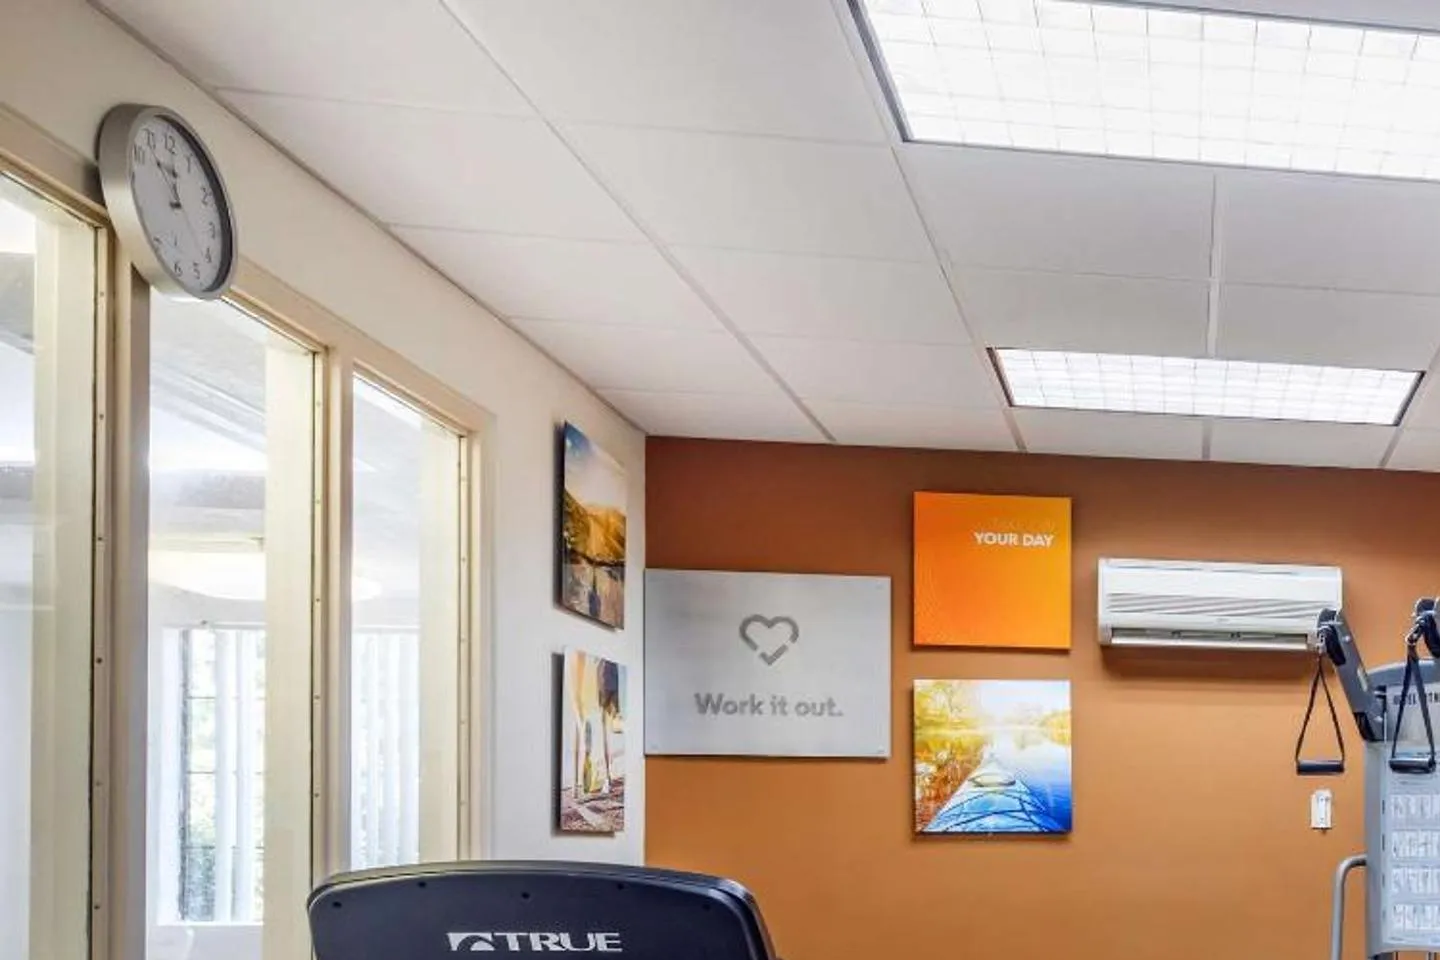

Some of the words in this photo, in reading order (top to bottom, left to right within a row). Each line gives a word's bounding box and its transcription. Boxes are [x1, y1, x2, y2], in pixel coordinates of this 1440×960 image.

[163, 132, 177, 155] 12
[973, 531, 1019, 547] YOUR
[1021, 533, 1056, 549] DAY
[693, 692, 765, 716] Work
[770, 694, 789, 716] it
[794, 697, 845, 718] out.
[492, 931, 624, 953] TRUE
